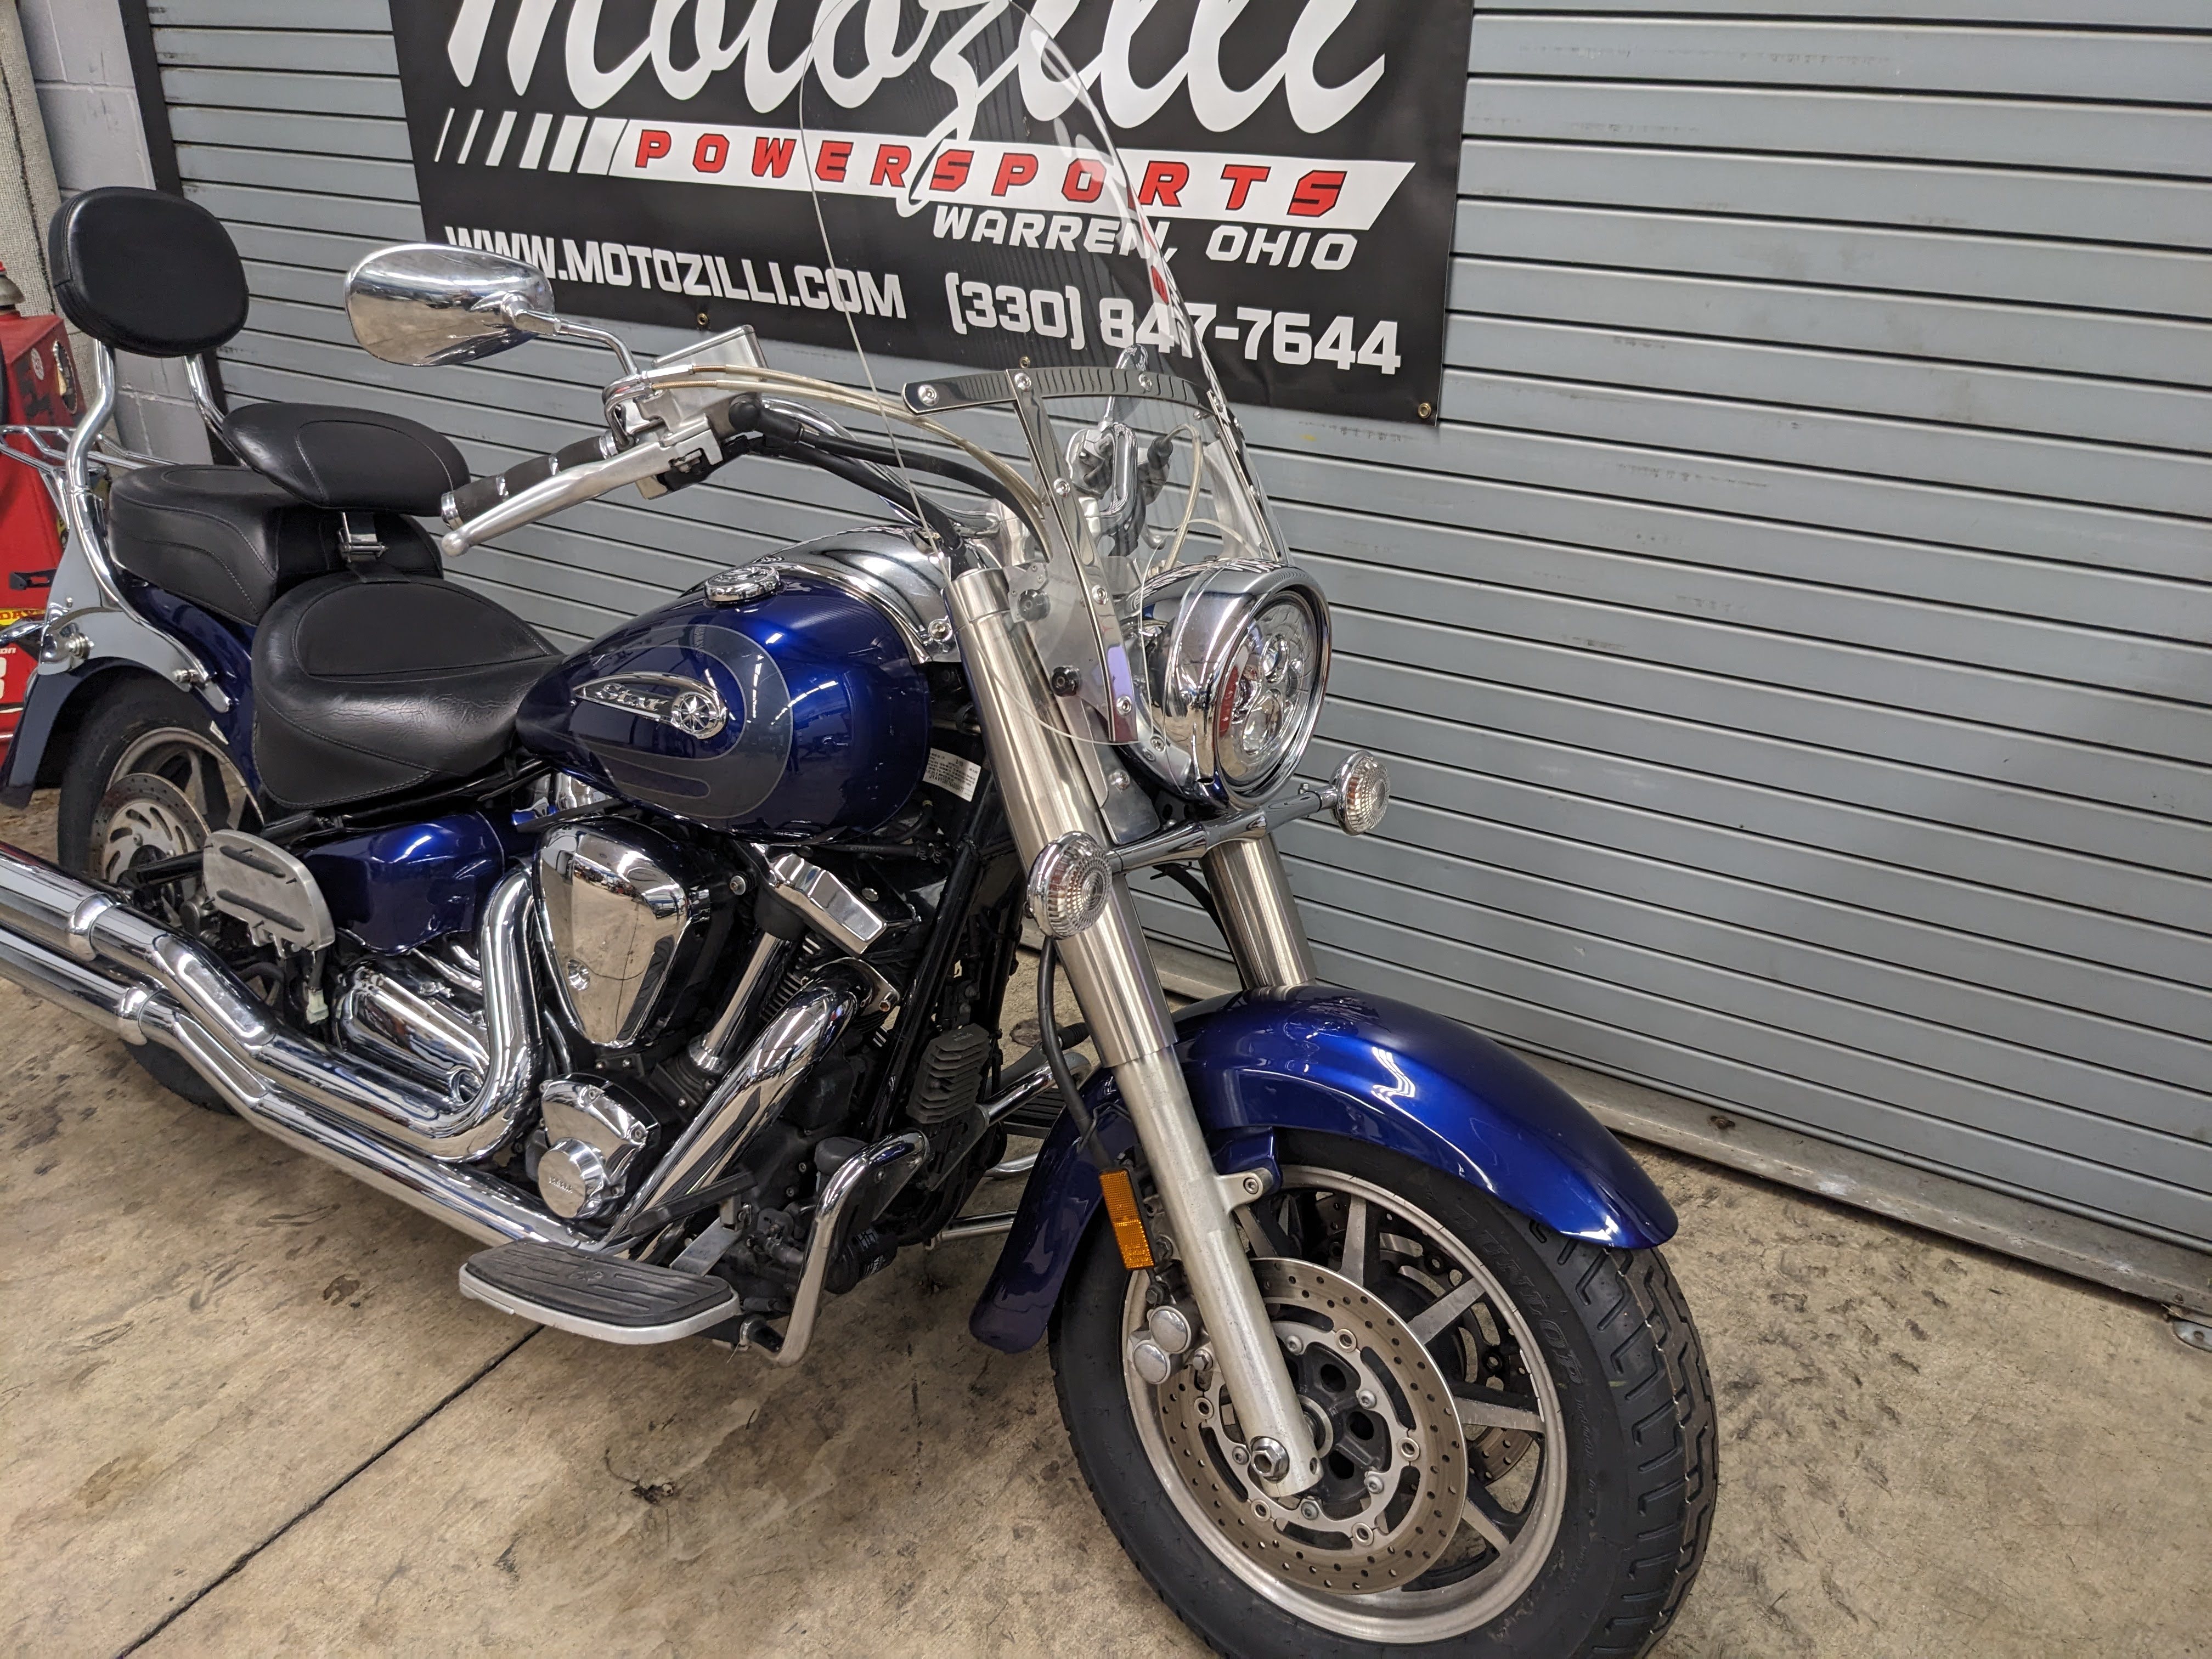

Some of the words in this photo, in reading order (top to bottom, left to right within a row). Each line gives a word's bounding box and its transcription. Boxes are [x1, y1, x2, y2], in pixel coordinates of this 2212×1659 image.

[635, 129, 1348, 217] POWERSPORTS
[933, 205, 1178, 263] WARREN,
[1206, 225, 1358, 270] OHIO
[945, 273, 1085, 350] (330)
[1099, 297, 1401, 374] 847-7644
[1453, 1203, 1584, 1385] DUNLOP
